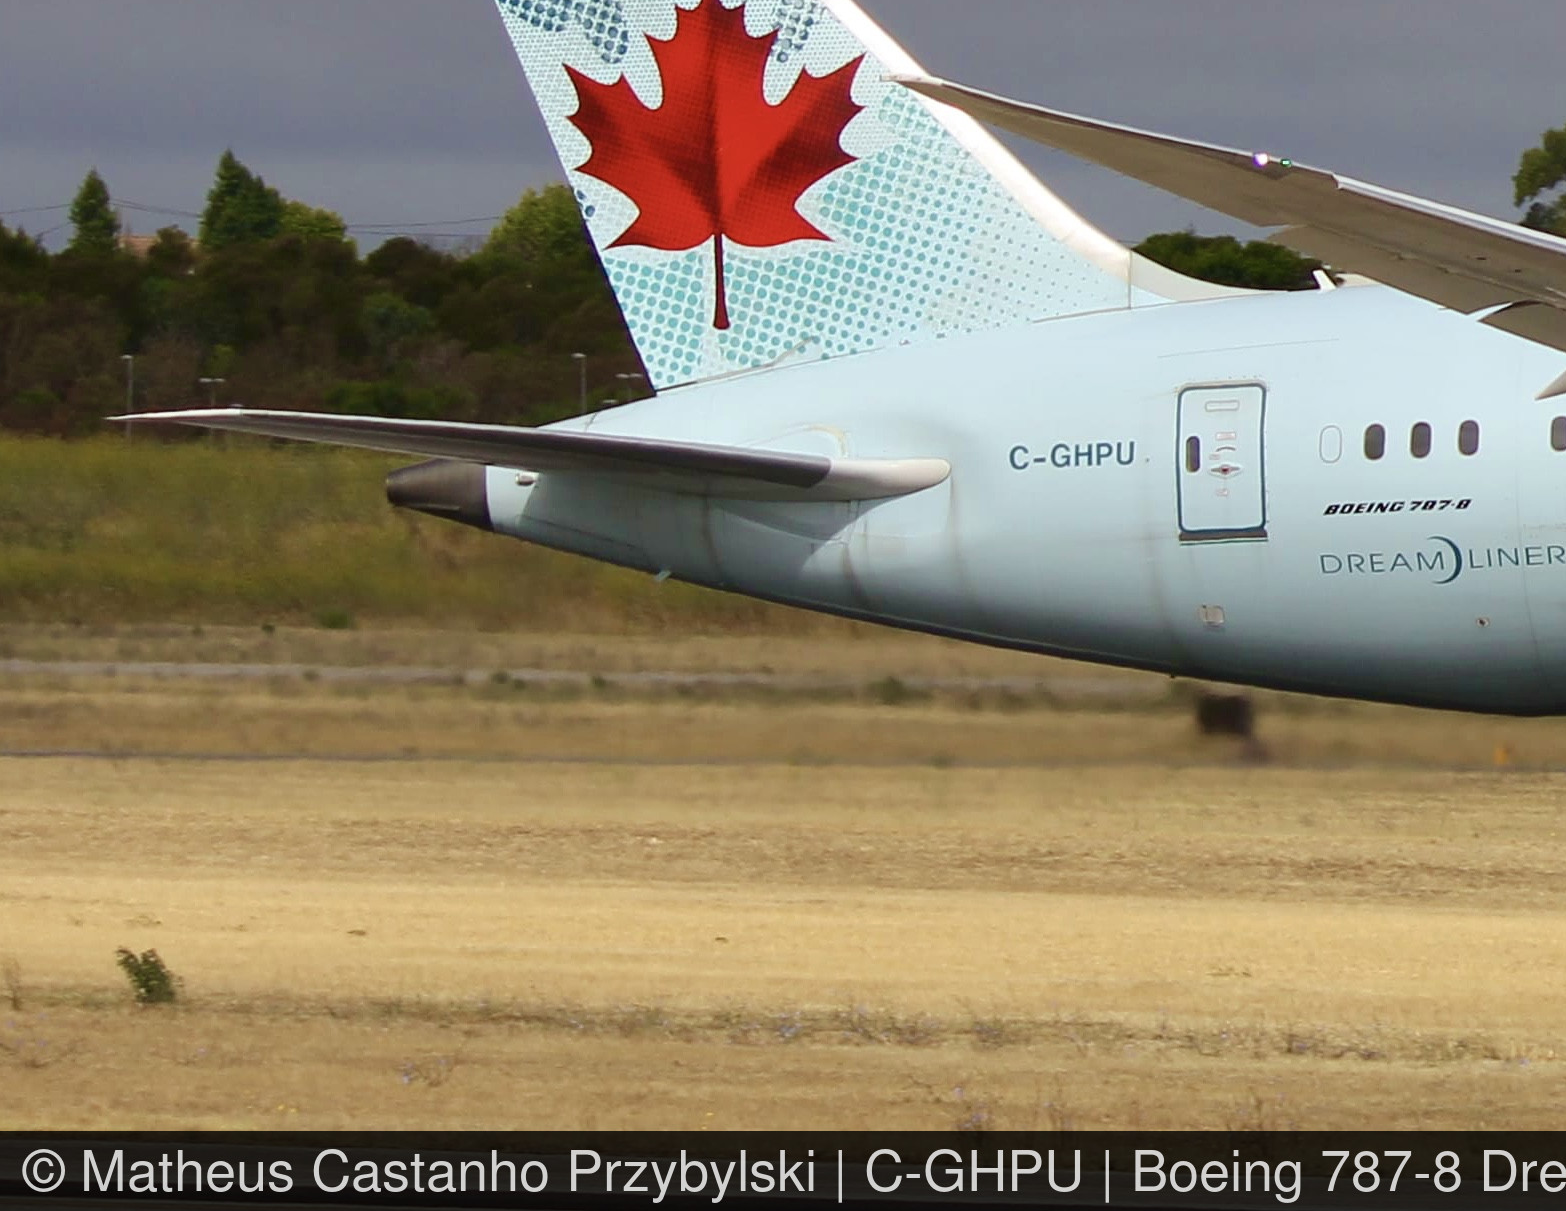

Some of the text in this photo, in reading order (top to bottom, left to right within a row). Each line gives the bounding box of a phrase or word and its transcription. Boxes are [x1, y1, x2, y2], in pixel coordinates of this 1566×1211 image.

[1008, 440, 1135, 471] C-GHPU
[1322, 498, 1473, 516] BOEING 787-8
